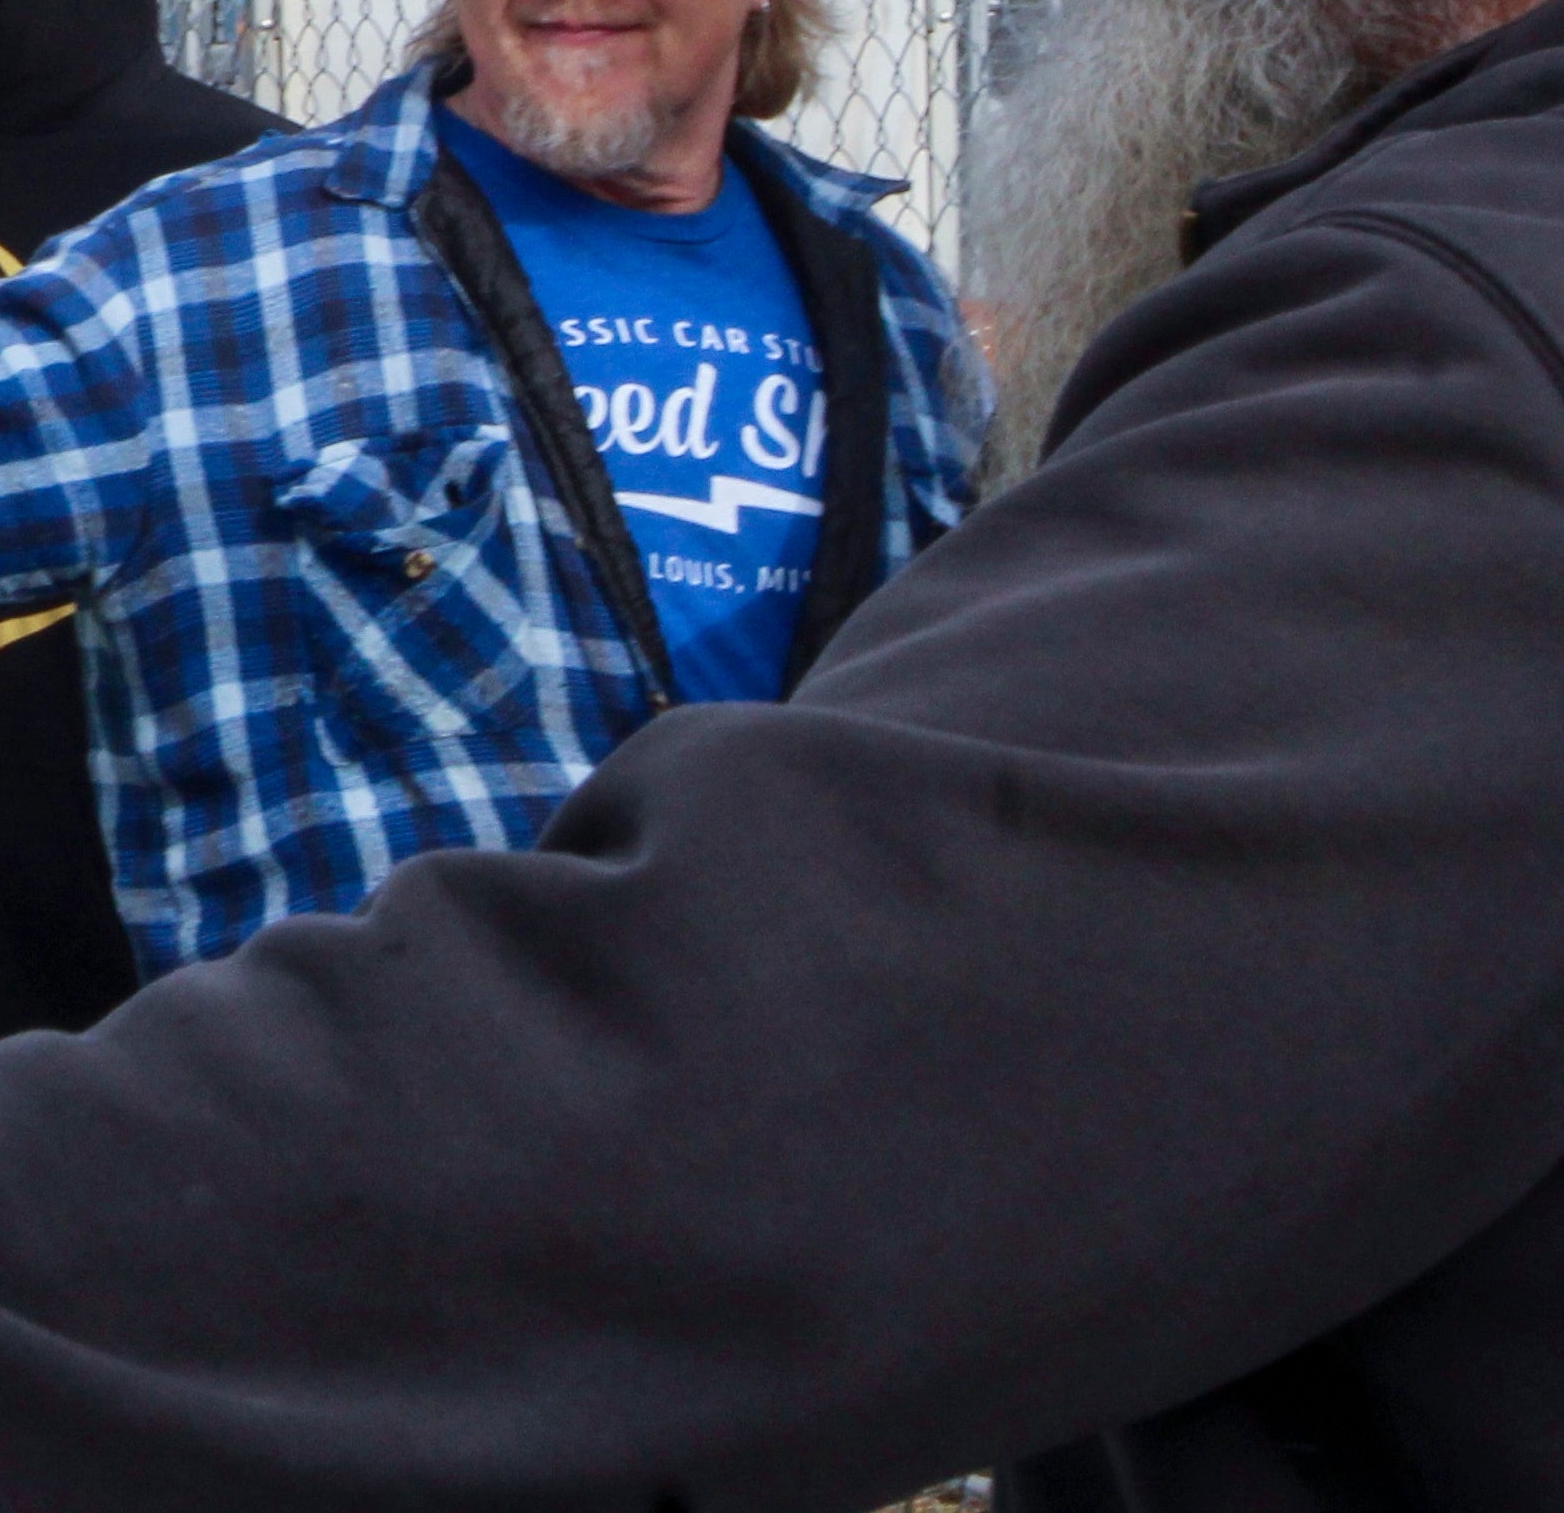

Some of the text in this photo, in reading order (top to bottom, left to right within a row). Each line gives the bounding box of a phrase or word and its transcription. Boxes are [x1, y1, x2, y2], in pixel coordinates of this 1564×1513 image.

[557, 317, 659, 347] SSIC
[672, 320, 751, 355] CAR
[647, 551, 746, 595] LOUIS,
